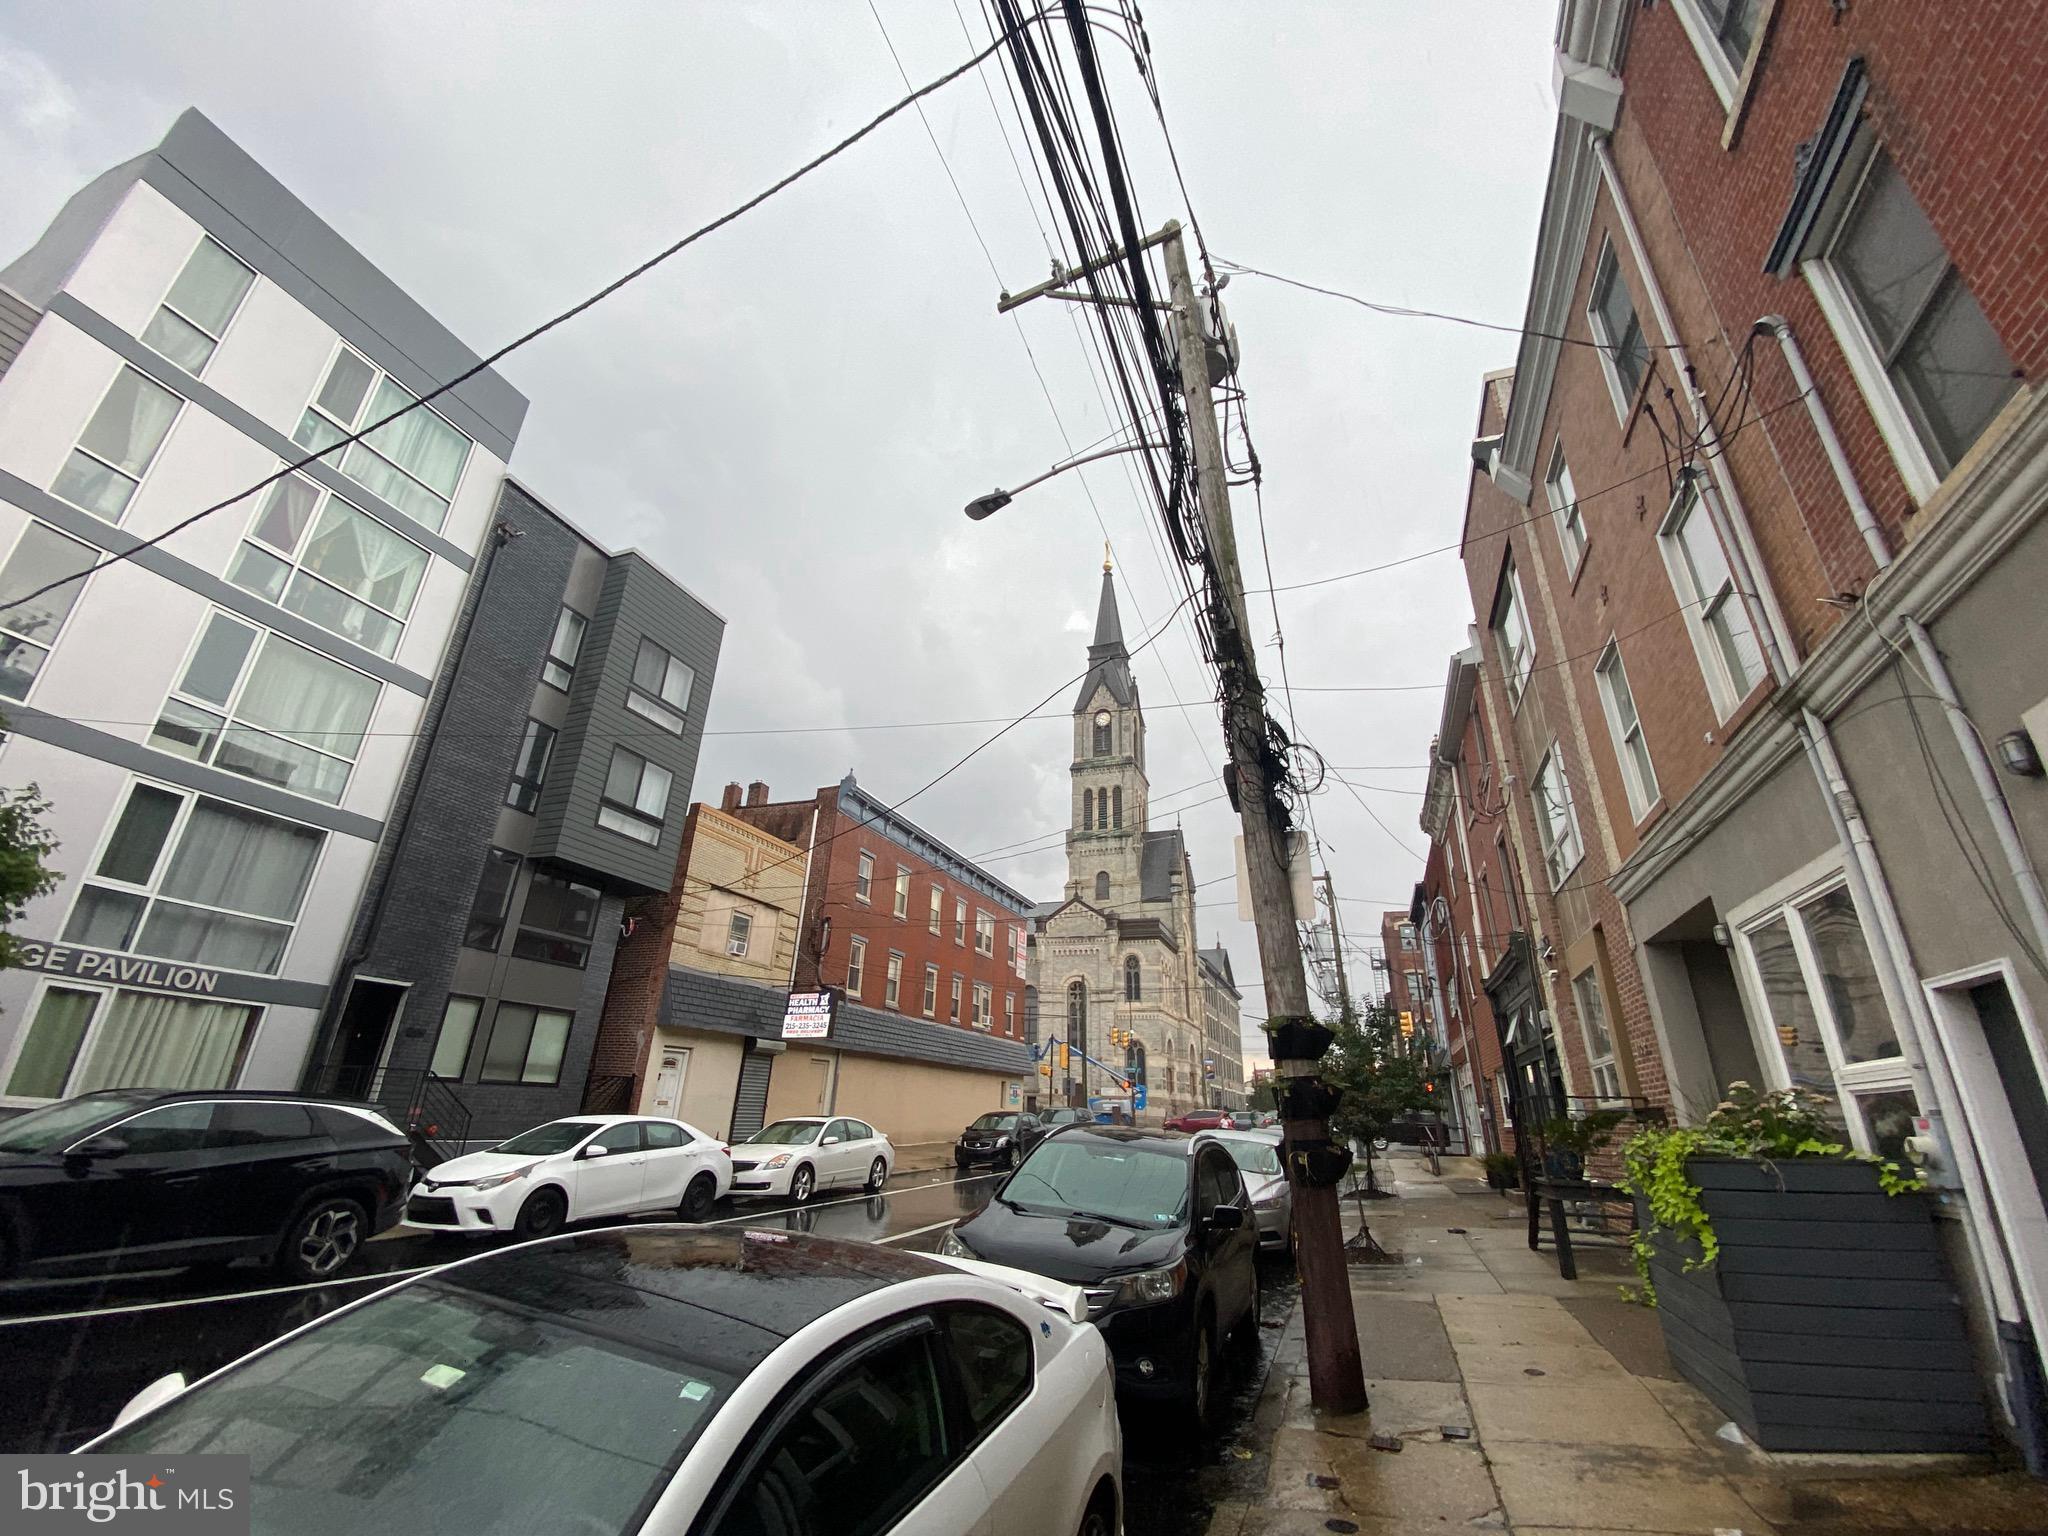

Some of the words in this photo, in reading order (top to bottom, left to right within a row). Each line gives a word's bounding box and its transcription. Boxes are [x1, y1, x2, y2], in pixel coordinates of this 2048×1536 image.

[20, 944, 70, 971] GE
[76, 952, 219, 992] PAVILION
[787, 1006, 830, 1014] PHARMACY
